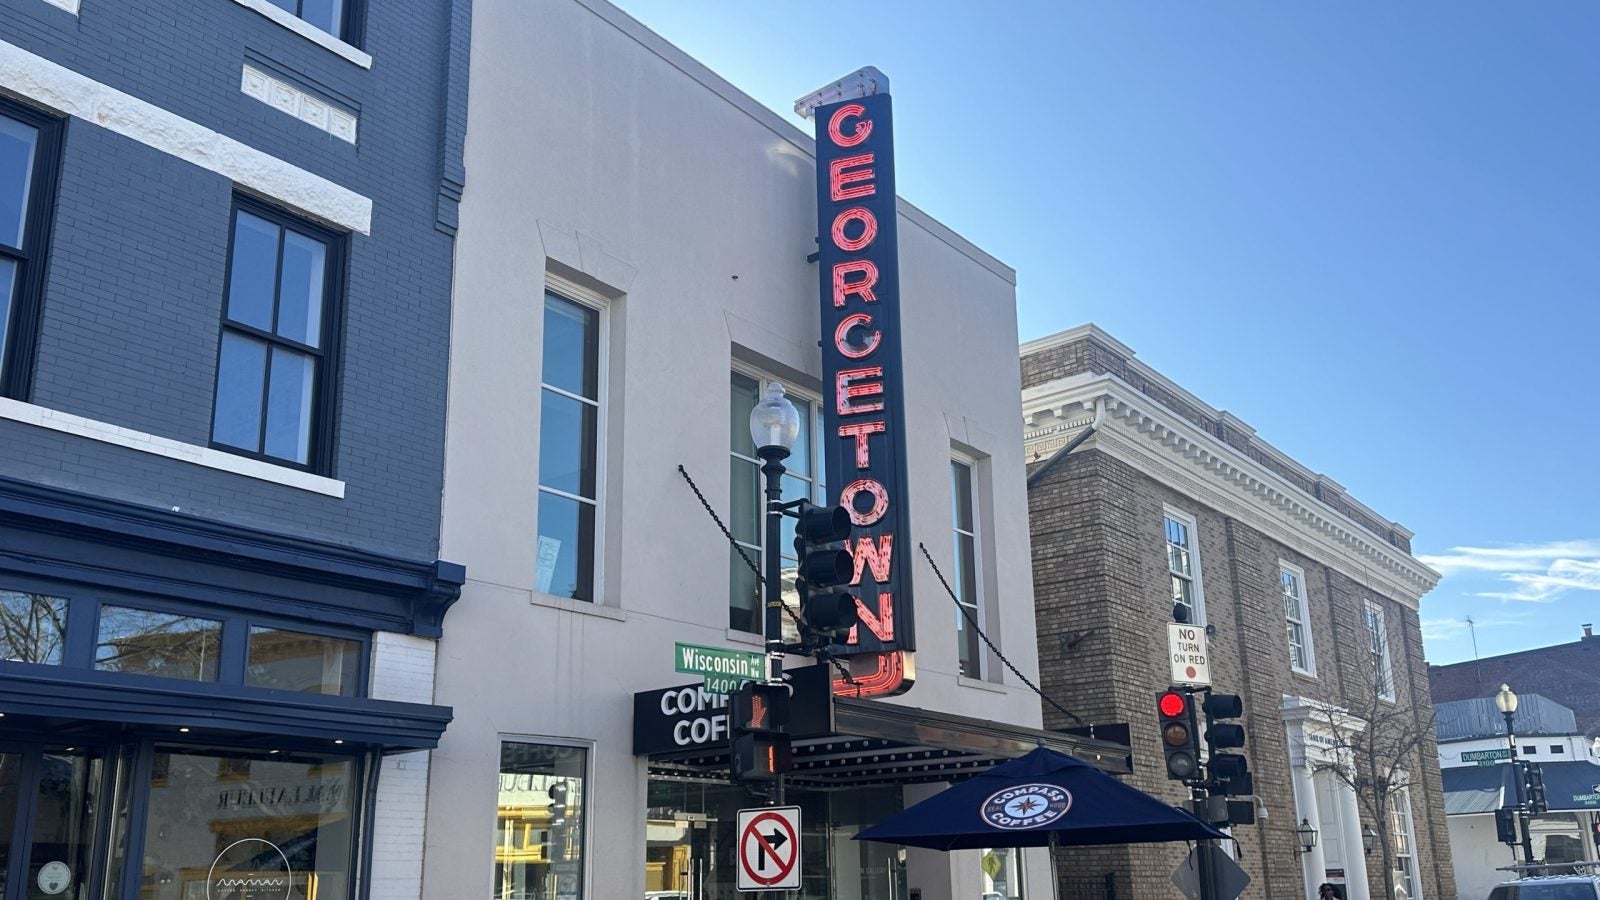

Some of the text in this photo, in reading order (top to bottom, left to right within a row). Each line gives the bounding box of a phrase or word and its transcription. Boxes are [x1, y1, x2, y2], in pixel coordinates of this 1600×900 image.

[827, 104, 894, 644] GEORGETOWN
[1179, 628, 1195, 640] NO
[1177, 642, 1199, 652] TURN
[682, 648, 748, 675] Wisconsin
[1173, 654, 1205, 665] ON RED
[706, 678, 736, 693] 1400
[673, 715, 730, 746] COF
[1463, 751, 1502, 762] DUMBARTON
[993, 786, 1064, 804] COMPASS
[1573, 793, 1600, 801] DUMBARTO
[991, 810, 1058, 826] COFFEE
